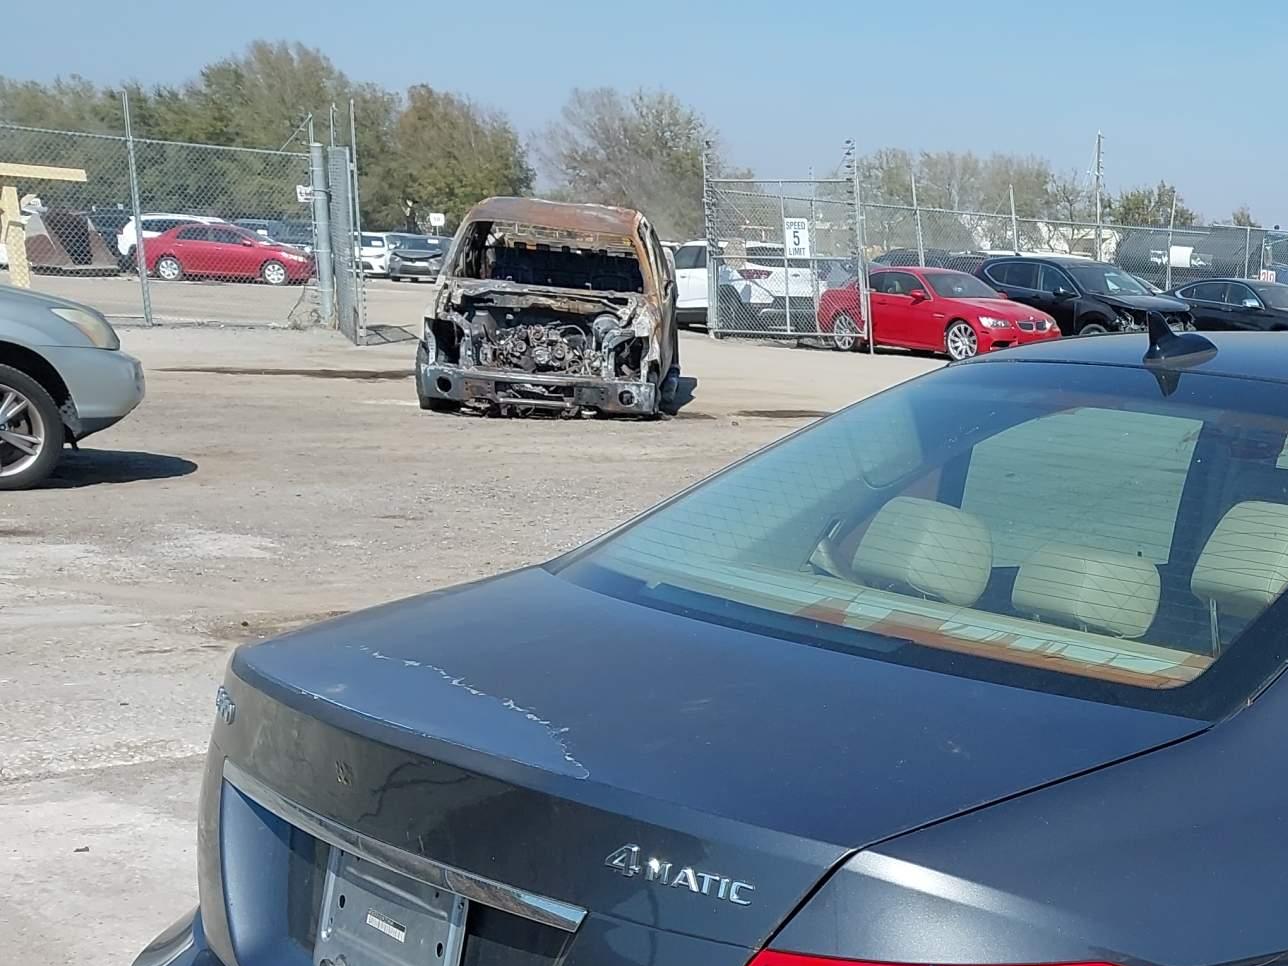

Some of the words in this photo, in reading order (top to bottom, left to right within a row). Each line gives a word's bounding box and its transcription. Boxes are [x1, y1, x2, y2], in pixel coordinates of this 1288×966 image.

[785, 221, 806, 230] SPEED
[793, 230, 800, 246] 5
[788, 247, 806, 256] LIMIT
